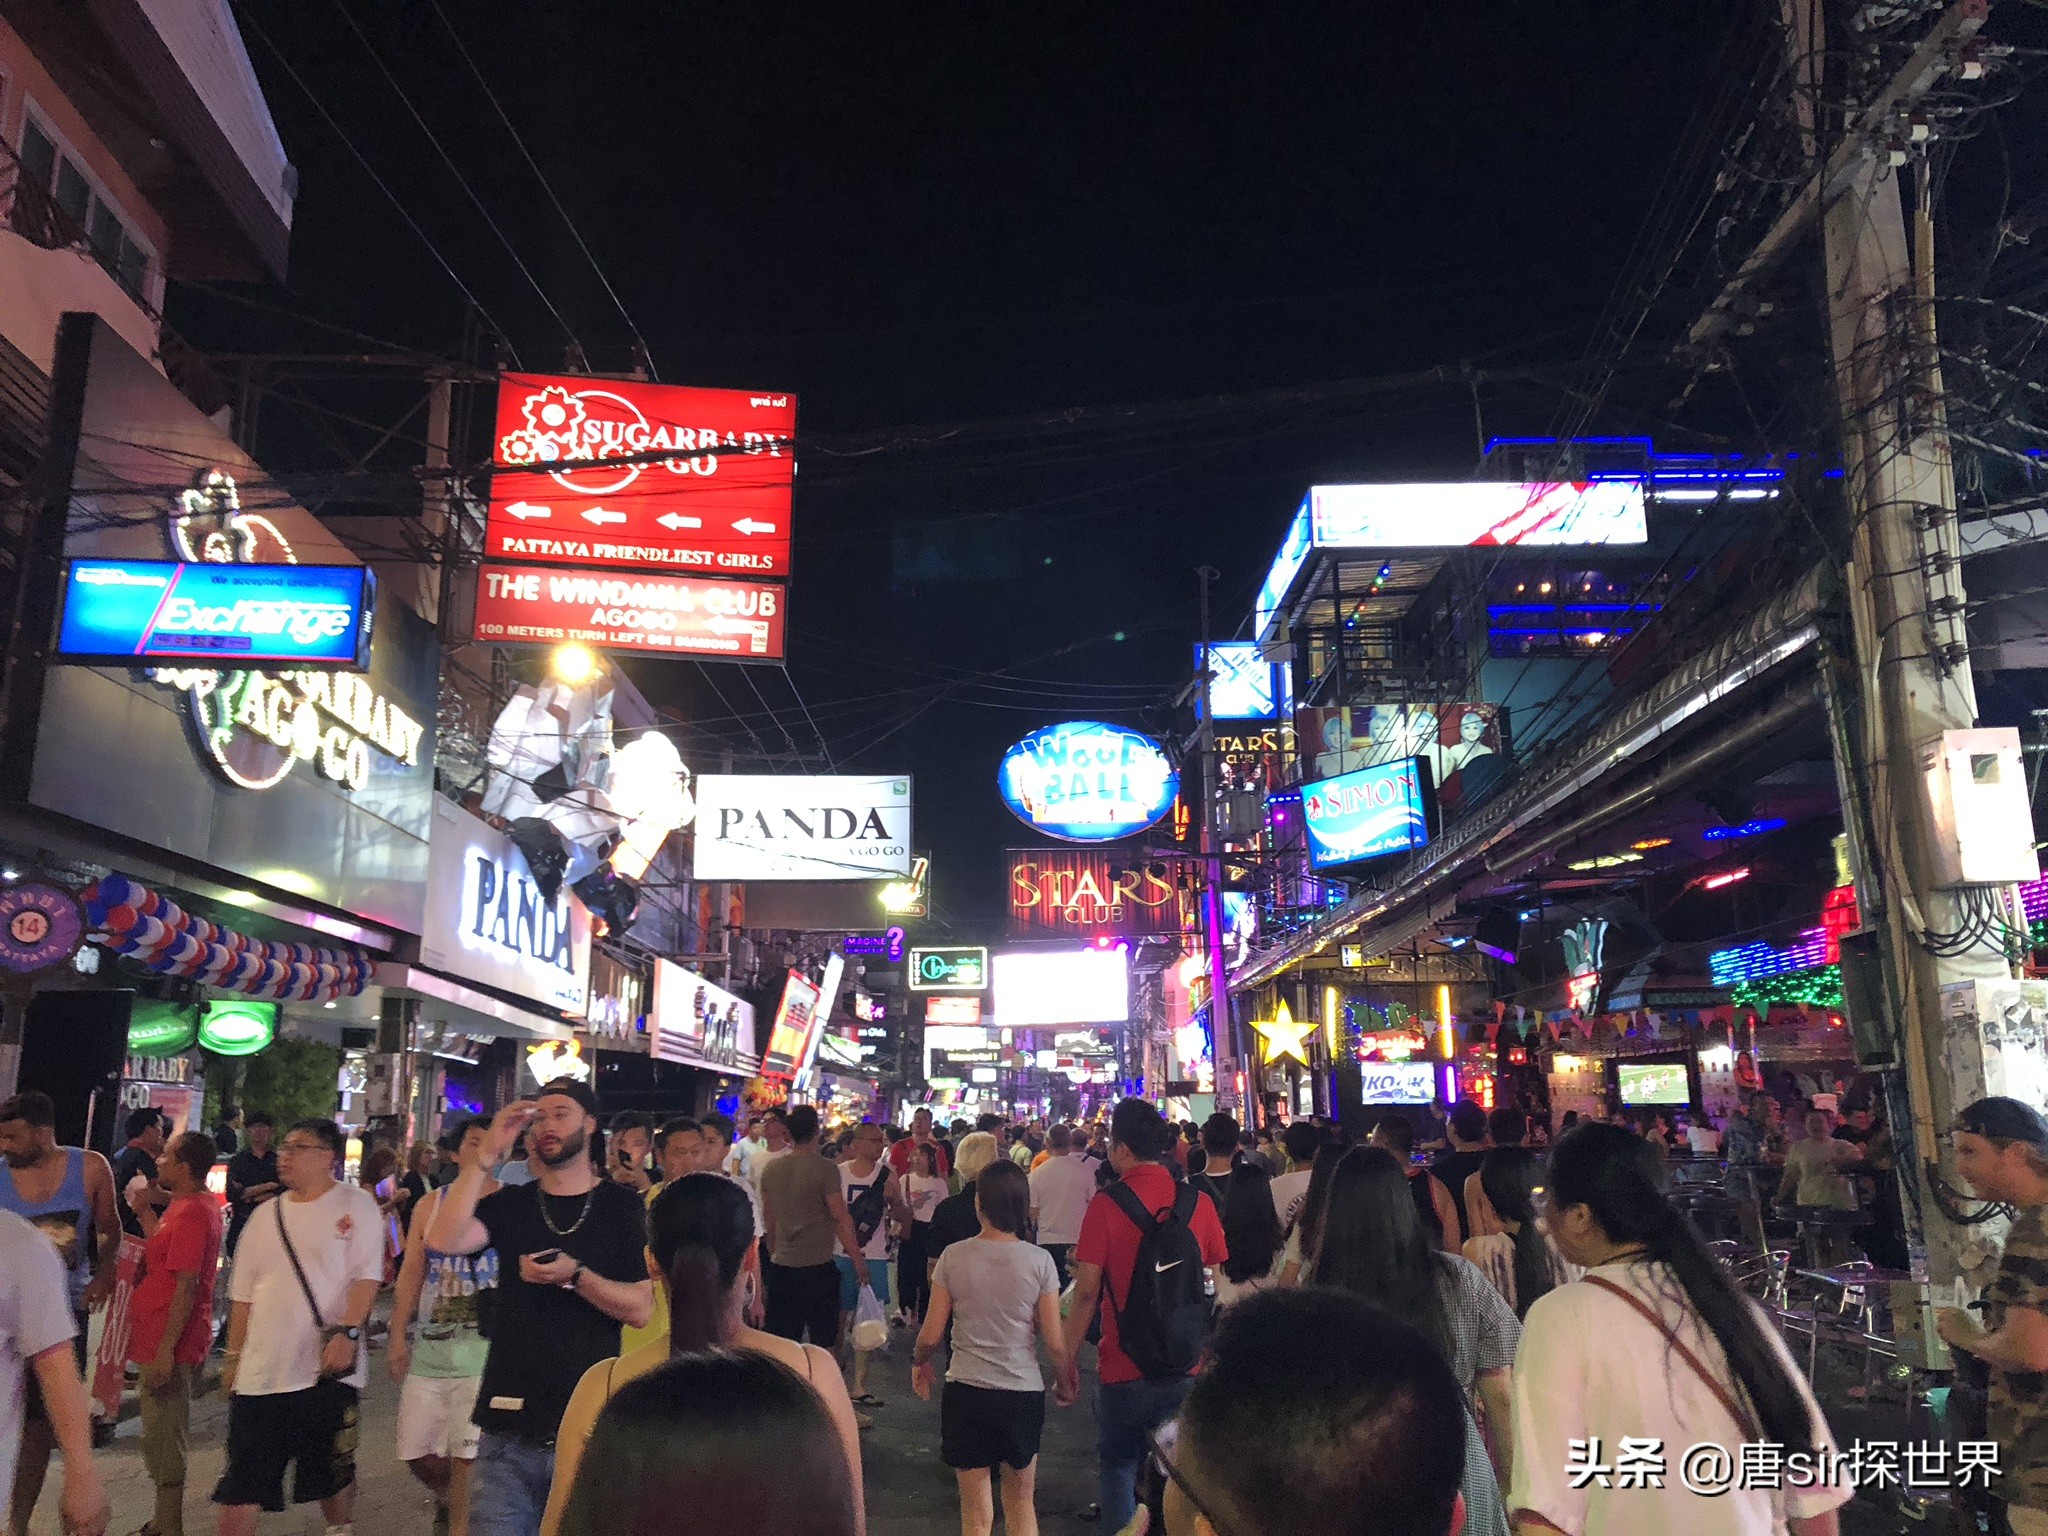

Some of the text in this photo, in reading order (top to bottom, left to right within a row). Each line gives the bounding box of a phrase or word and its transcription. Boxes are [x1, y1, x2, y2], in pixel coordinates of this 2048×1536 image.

[501, 537, 774, 570] PATTAYA FRIENDLIEST GIRLS
[486, 572, 777, 617] THE WINDMILL CLUB
[156, 597, 353, 645] Exchange
[479, 623, 505, 635] 100
[506, 624, 565, 639] METERS
[567, 628, 607, 641] TURN
[609, 632, 645, 644] LEFT
[1325, 772, 1420, 818] SIMON
[718, 807, 893, 840] PANDA
[1012, 862, 1174, 908] STARS
[471, 856, 575, 977] PANDA
[1063, 905, 1125, 924] CLUB
[844, 937, 886, 946] IMAGINE
[146, 1055, 190, 1083] BABY
